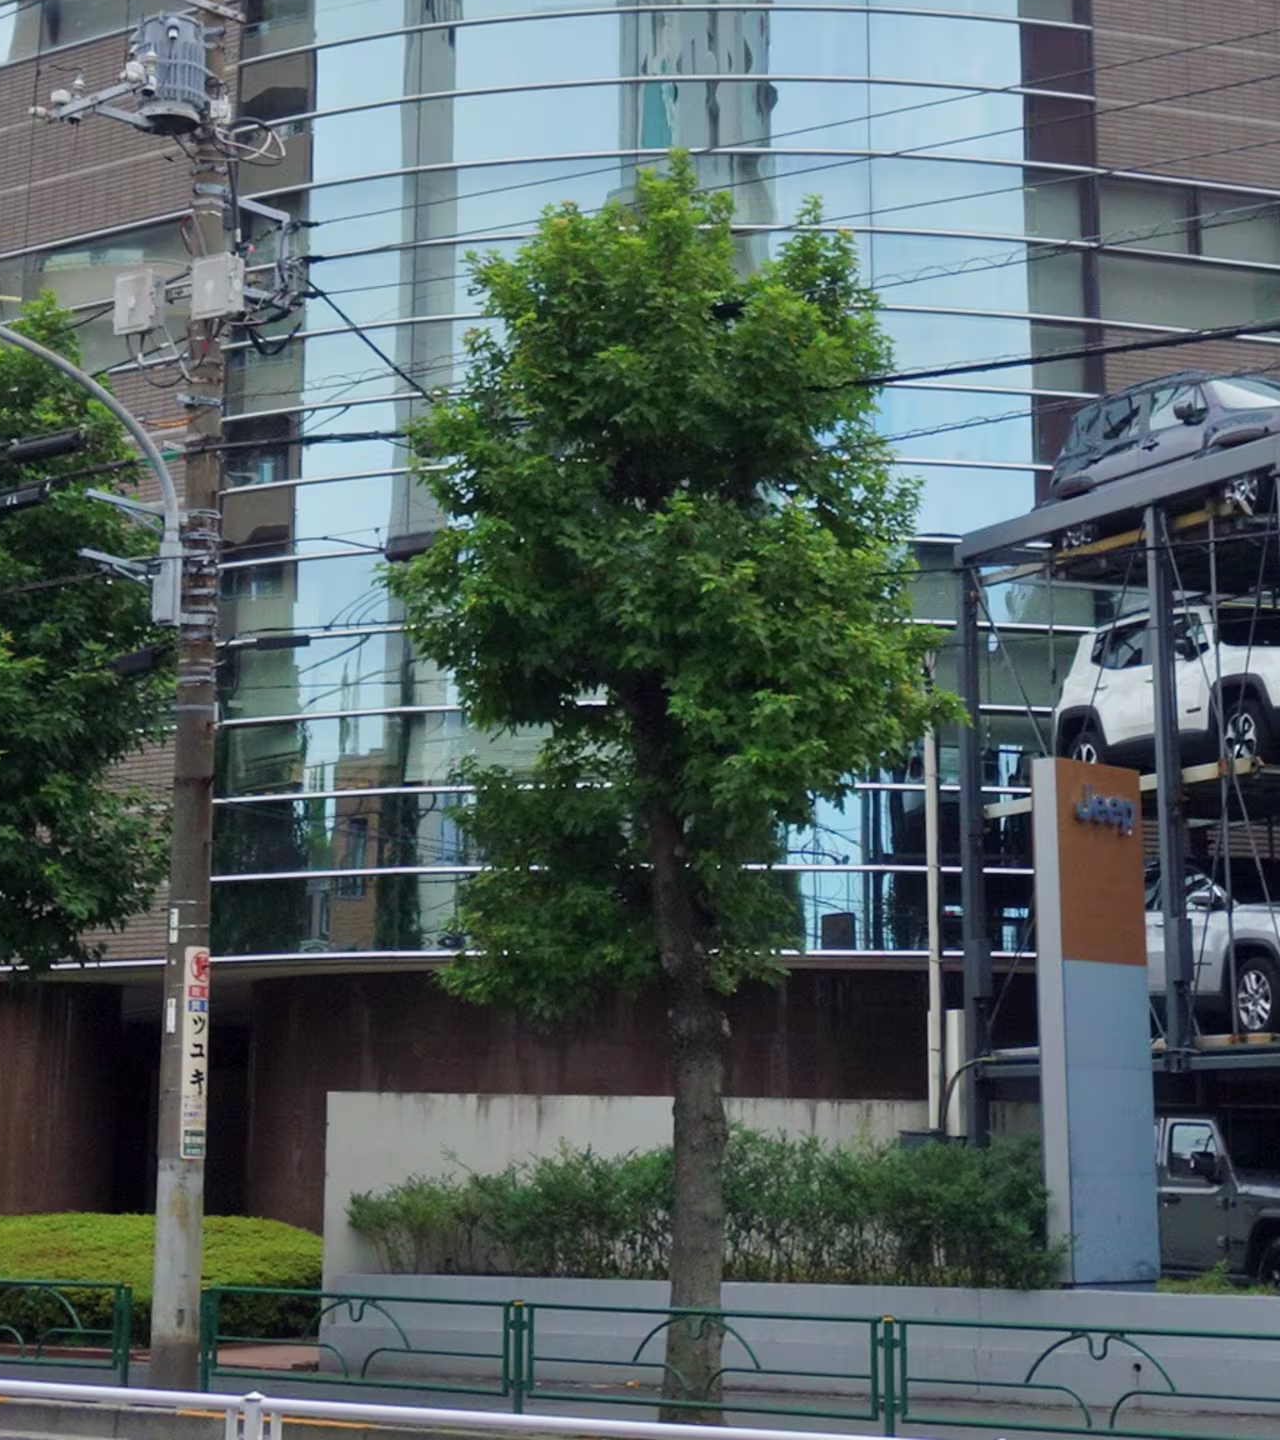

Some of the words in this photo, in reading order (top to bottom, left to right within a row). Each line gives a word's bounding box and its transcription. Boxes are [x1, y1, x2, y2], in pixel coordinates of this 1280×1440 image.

[1075, 784, 1137, 836] Jeep
[190, 1016, 206, 1096] ツユキ
